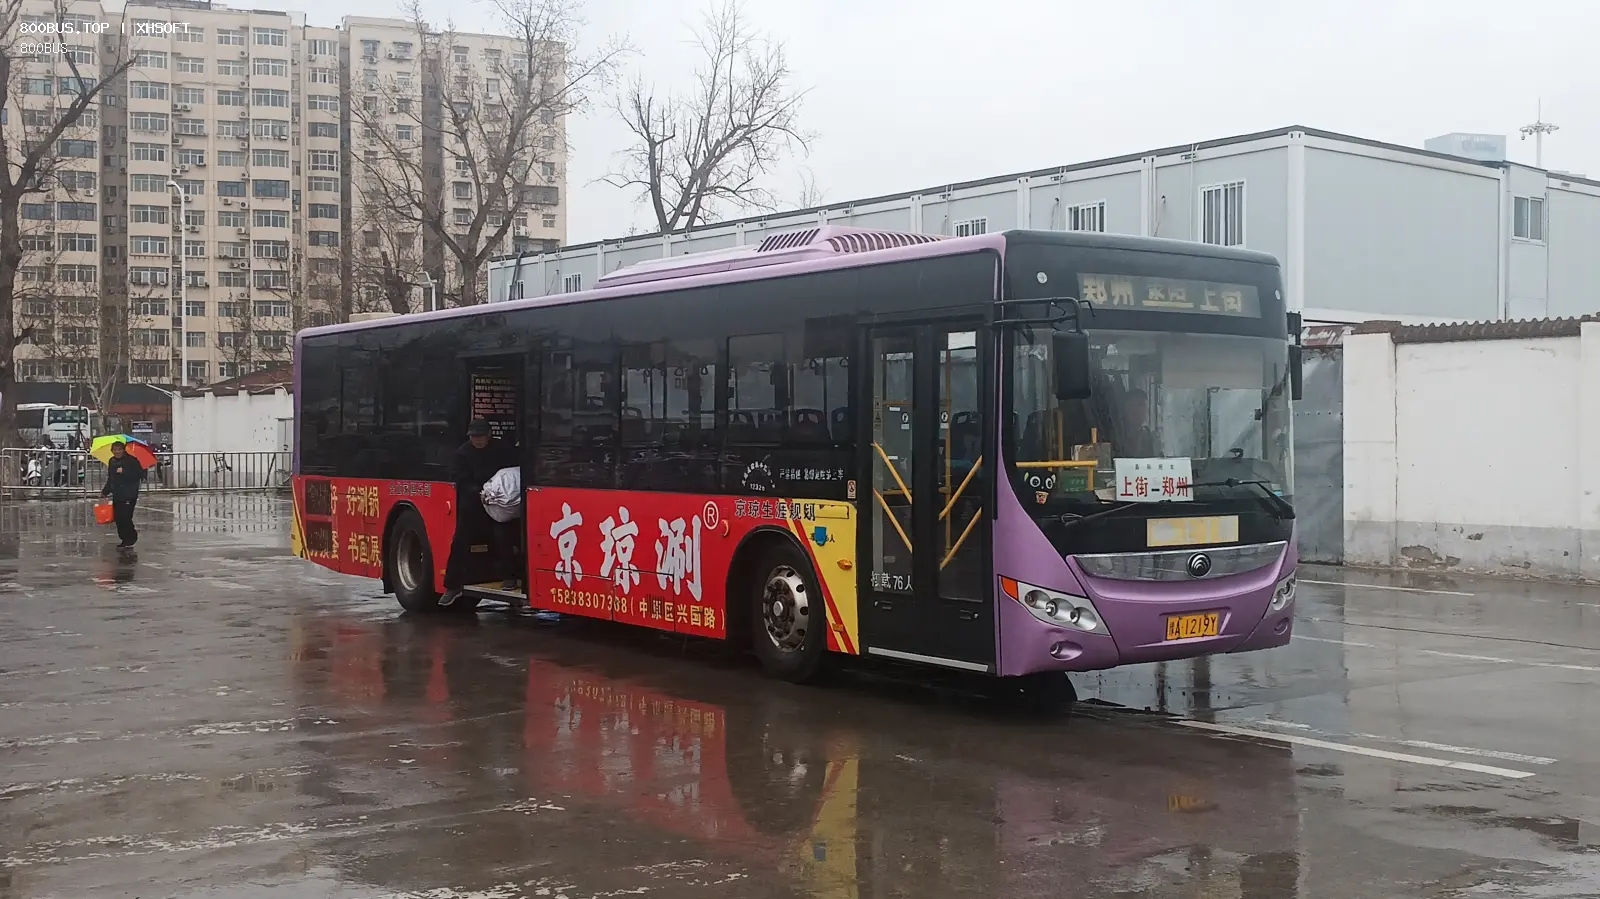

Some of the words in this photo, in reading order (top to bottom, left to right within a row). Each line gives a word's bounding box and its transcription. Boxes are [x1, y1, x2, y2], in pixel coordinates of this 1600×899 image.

[734, 498, 818, 522] 京琼生涯规划
